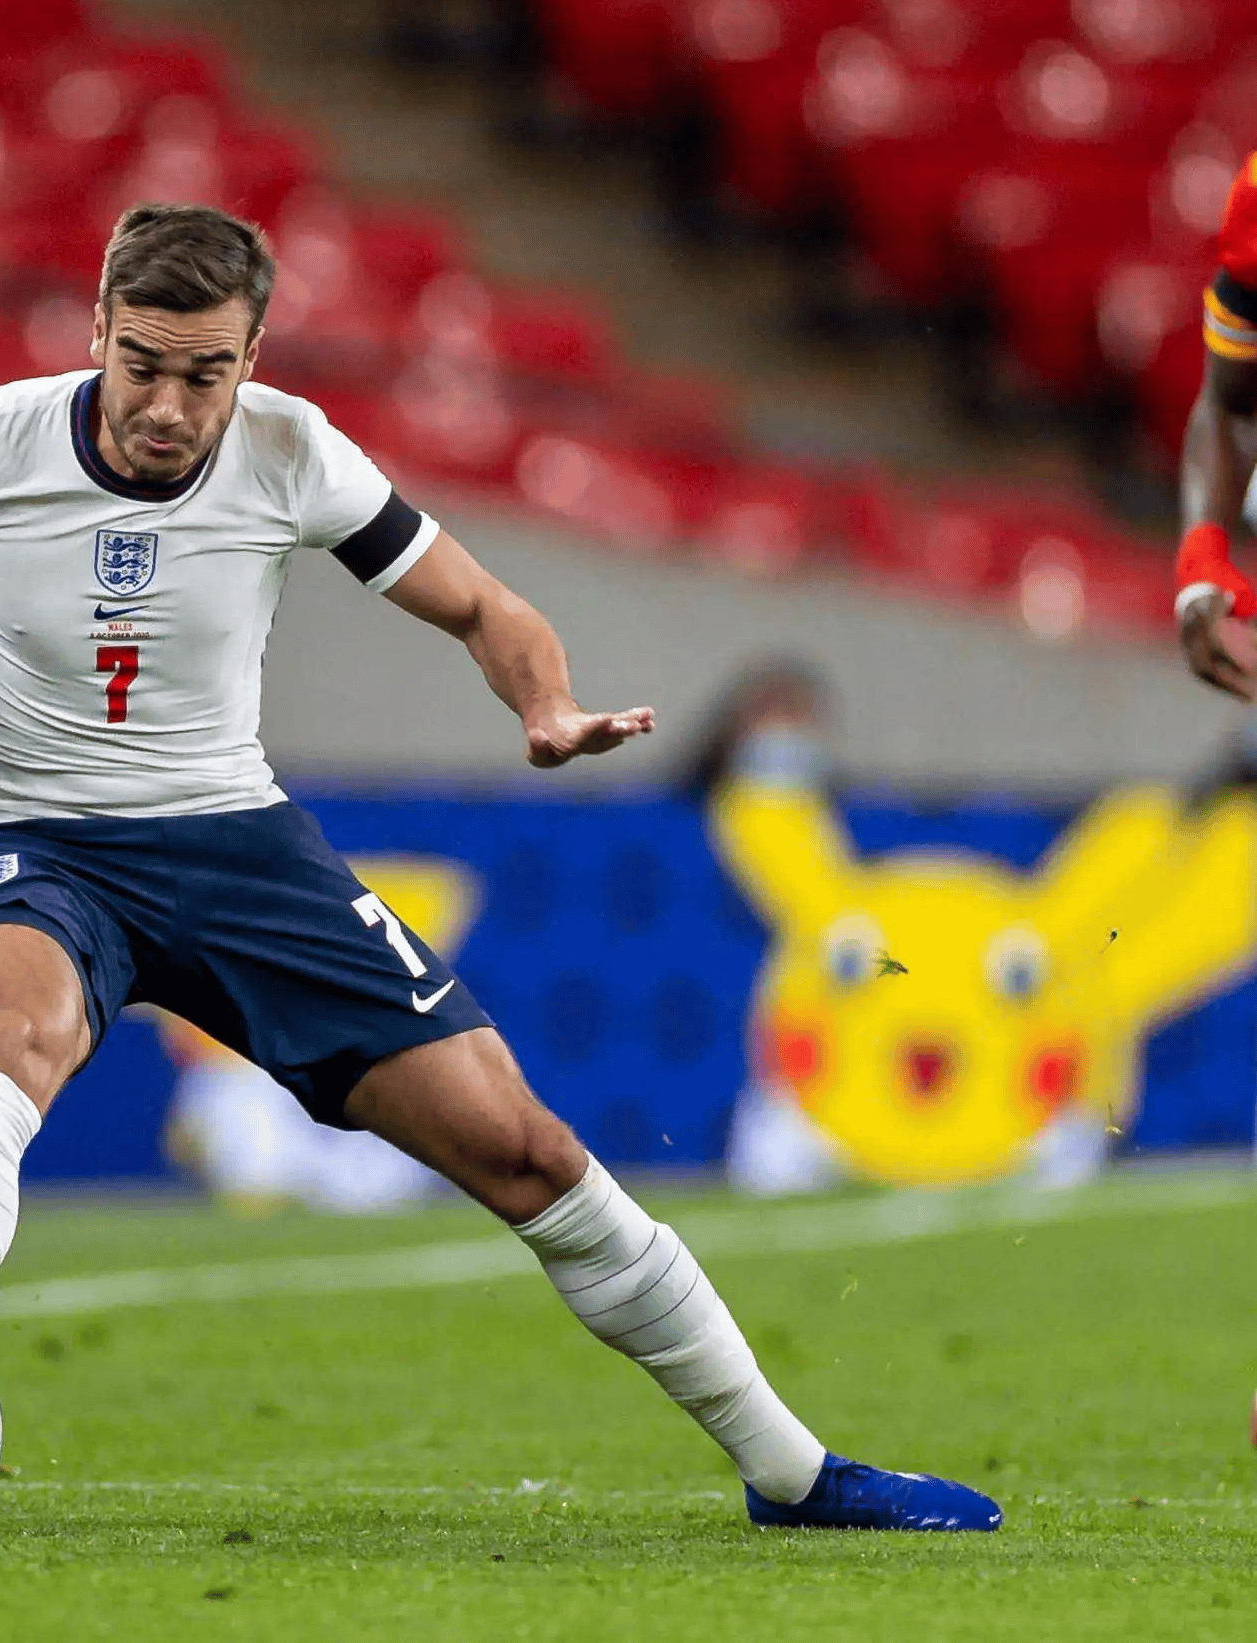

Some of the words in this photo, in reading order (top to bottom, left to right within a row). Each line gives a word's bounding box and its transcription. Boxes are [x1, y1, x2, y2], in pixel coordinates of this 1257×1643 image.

[107, 622, 134, 632] WALES
[95, 645, 140, 724] 7
[350, 892, 428, 979] 7
